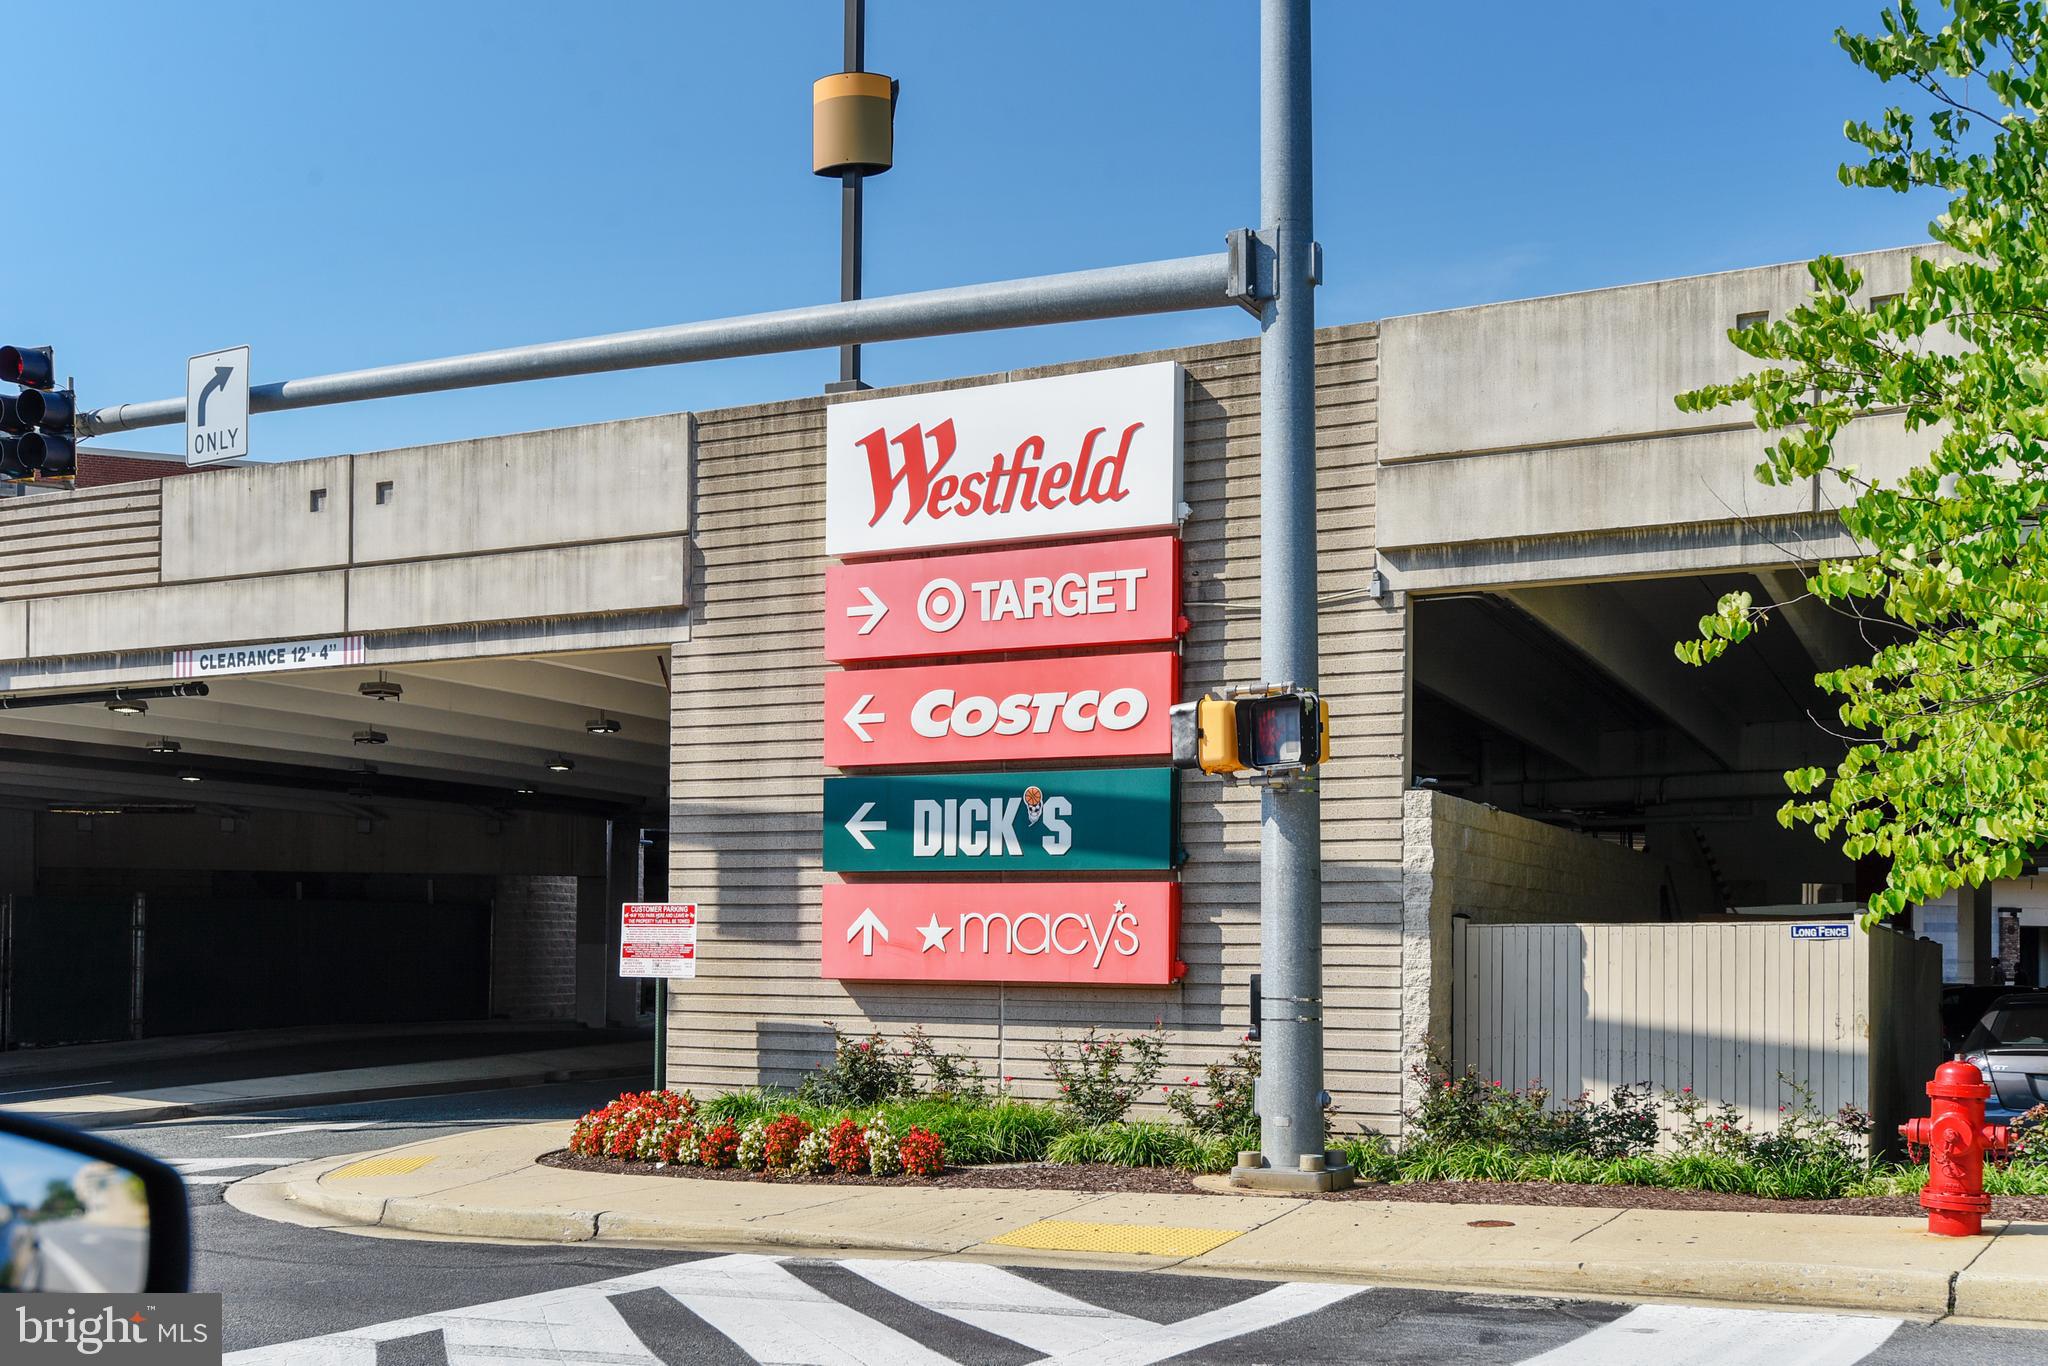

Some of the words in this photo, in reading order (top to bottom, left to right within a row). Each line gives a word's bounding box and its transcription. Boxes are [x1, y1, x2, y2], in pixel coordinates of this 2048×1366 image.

[194, 427, 238, 454] ONLY
[854, 417, 1145, 528] Westfield
[971, 567, 1148, 622] TARGET
[199, 648, 286, 670] CLEARANCE
[910, 687, 1149, 739] COSTCO
[913, 785, 1073, 857] DICK'S
[960, 898, 1141, 969] macy's
[1792, 926, 1817, 937] LONG
[1818, 926, 1847, 937] FENCE
